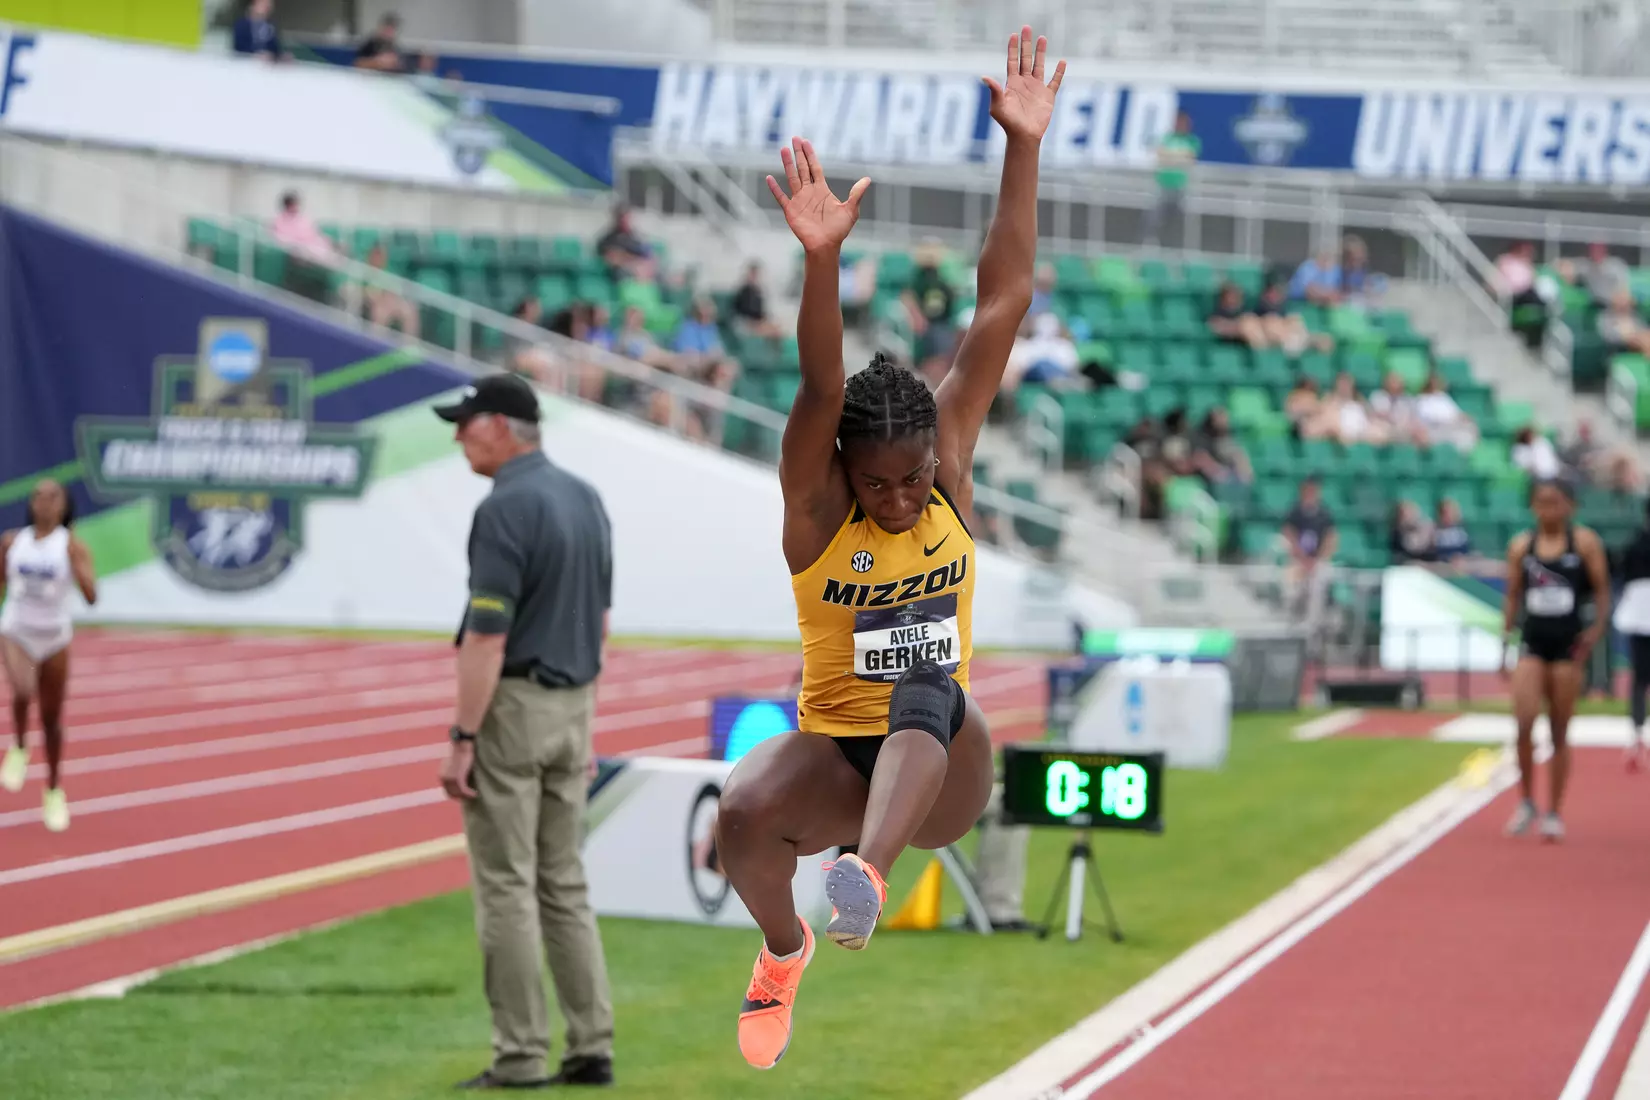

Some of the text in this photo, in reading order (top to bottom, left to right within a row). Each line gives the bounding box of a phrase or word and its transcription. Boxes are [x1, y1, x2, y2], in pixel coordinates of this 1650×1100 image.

[652, 62, 979, 162] HAYWARD
[852, 552, 873, 572] SEC
[822, 553, 967, 607] MIZZOU
[890, 625, 929, 645] AYELE
[865, 637, 952, 671] GERKEN
[1046, 760, 1147, 819] 0:18
[760, 976, 786, 997] NIKE
